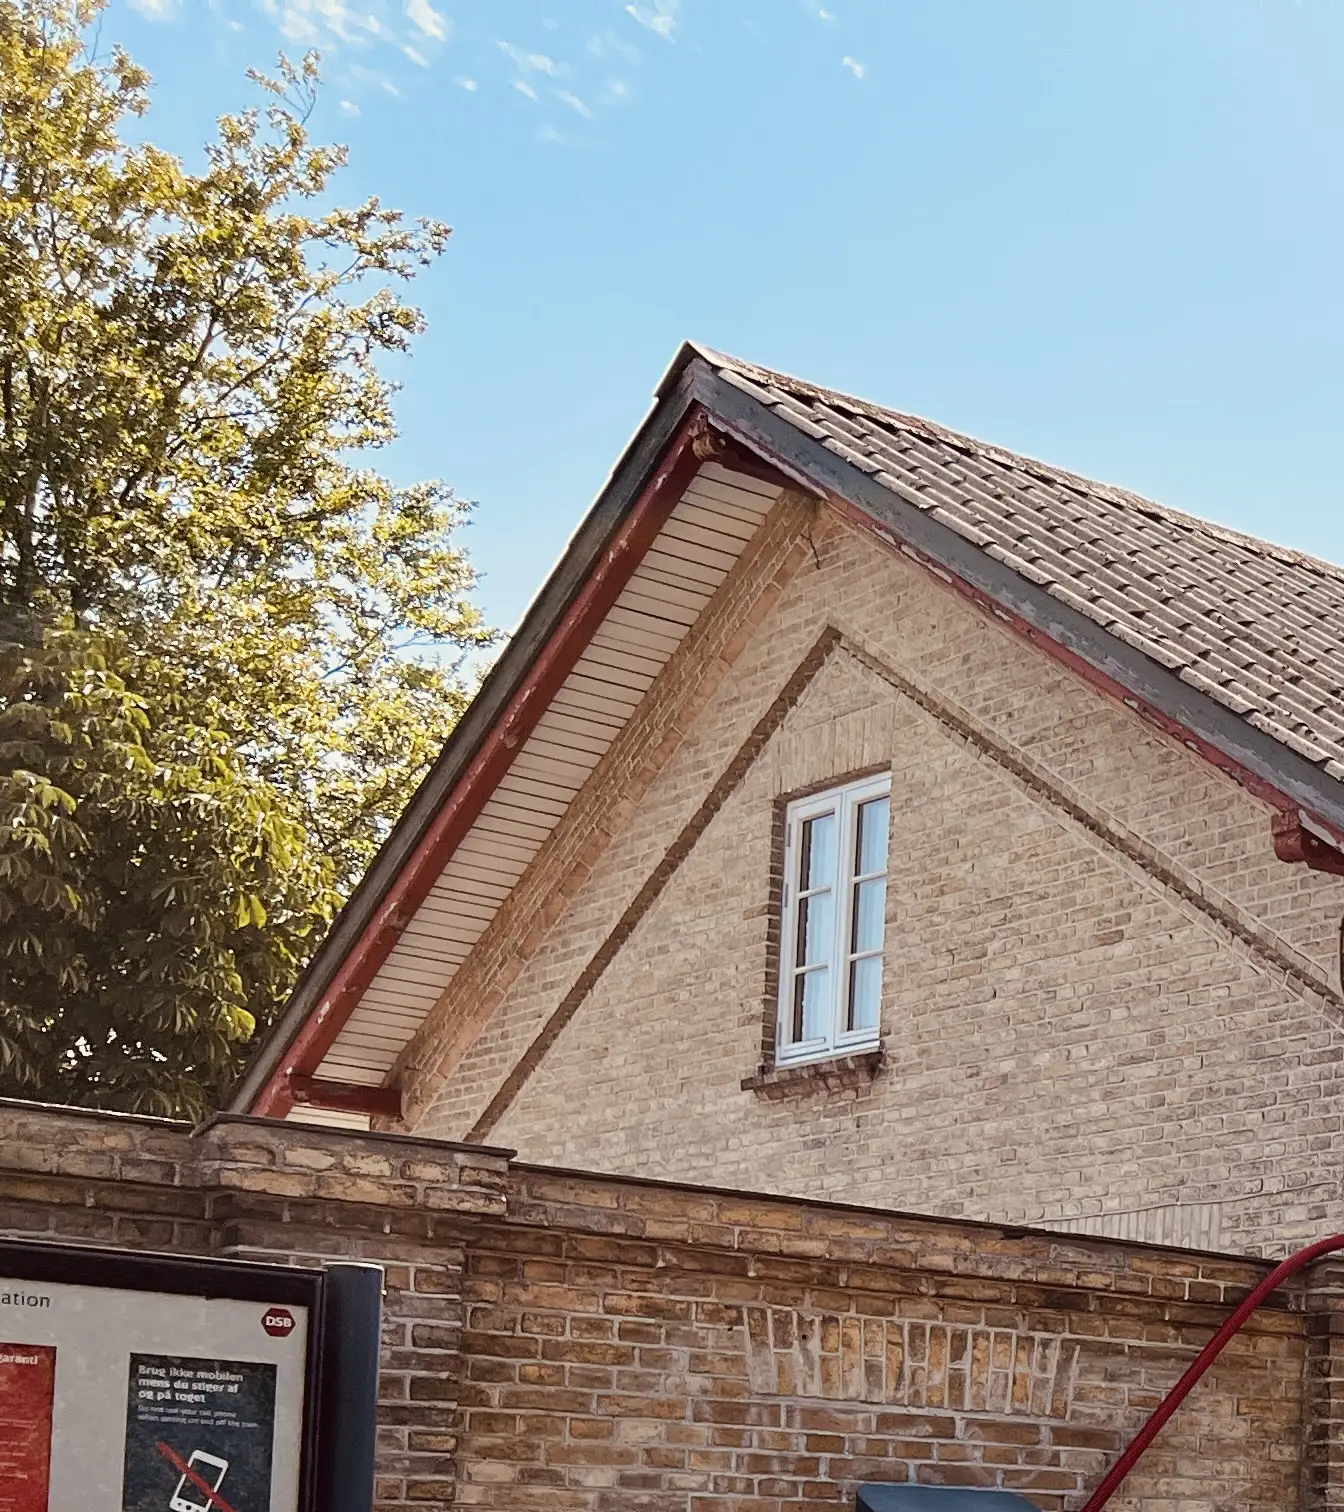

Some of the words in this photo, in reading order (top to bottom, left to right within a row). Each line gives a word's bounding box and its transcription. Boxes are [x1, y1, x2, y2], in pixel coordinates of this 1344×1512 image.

[2, 1291, 50, 1308] ation
[266, 1316, 292, 1327] DSB
[138, 1365, 166, 1377] Brug
[169, 1367, 194, 1378] ikke
[197, 1369, 244, 1382] mobilen
[138, 1379, 170, 1388] mens
[173, 1380, 188, 1390] du
[191, 1382, 224, 1393] stiger
[227, 1384, 239, 1394] af
[138, 1390, 154, 1400] og
[157, 1390, 172, 1401] på
[175, 1392, 206, 1403] toget
